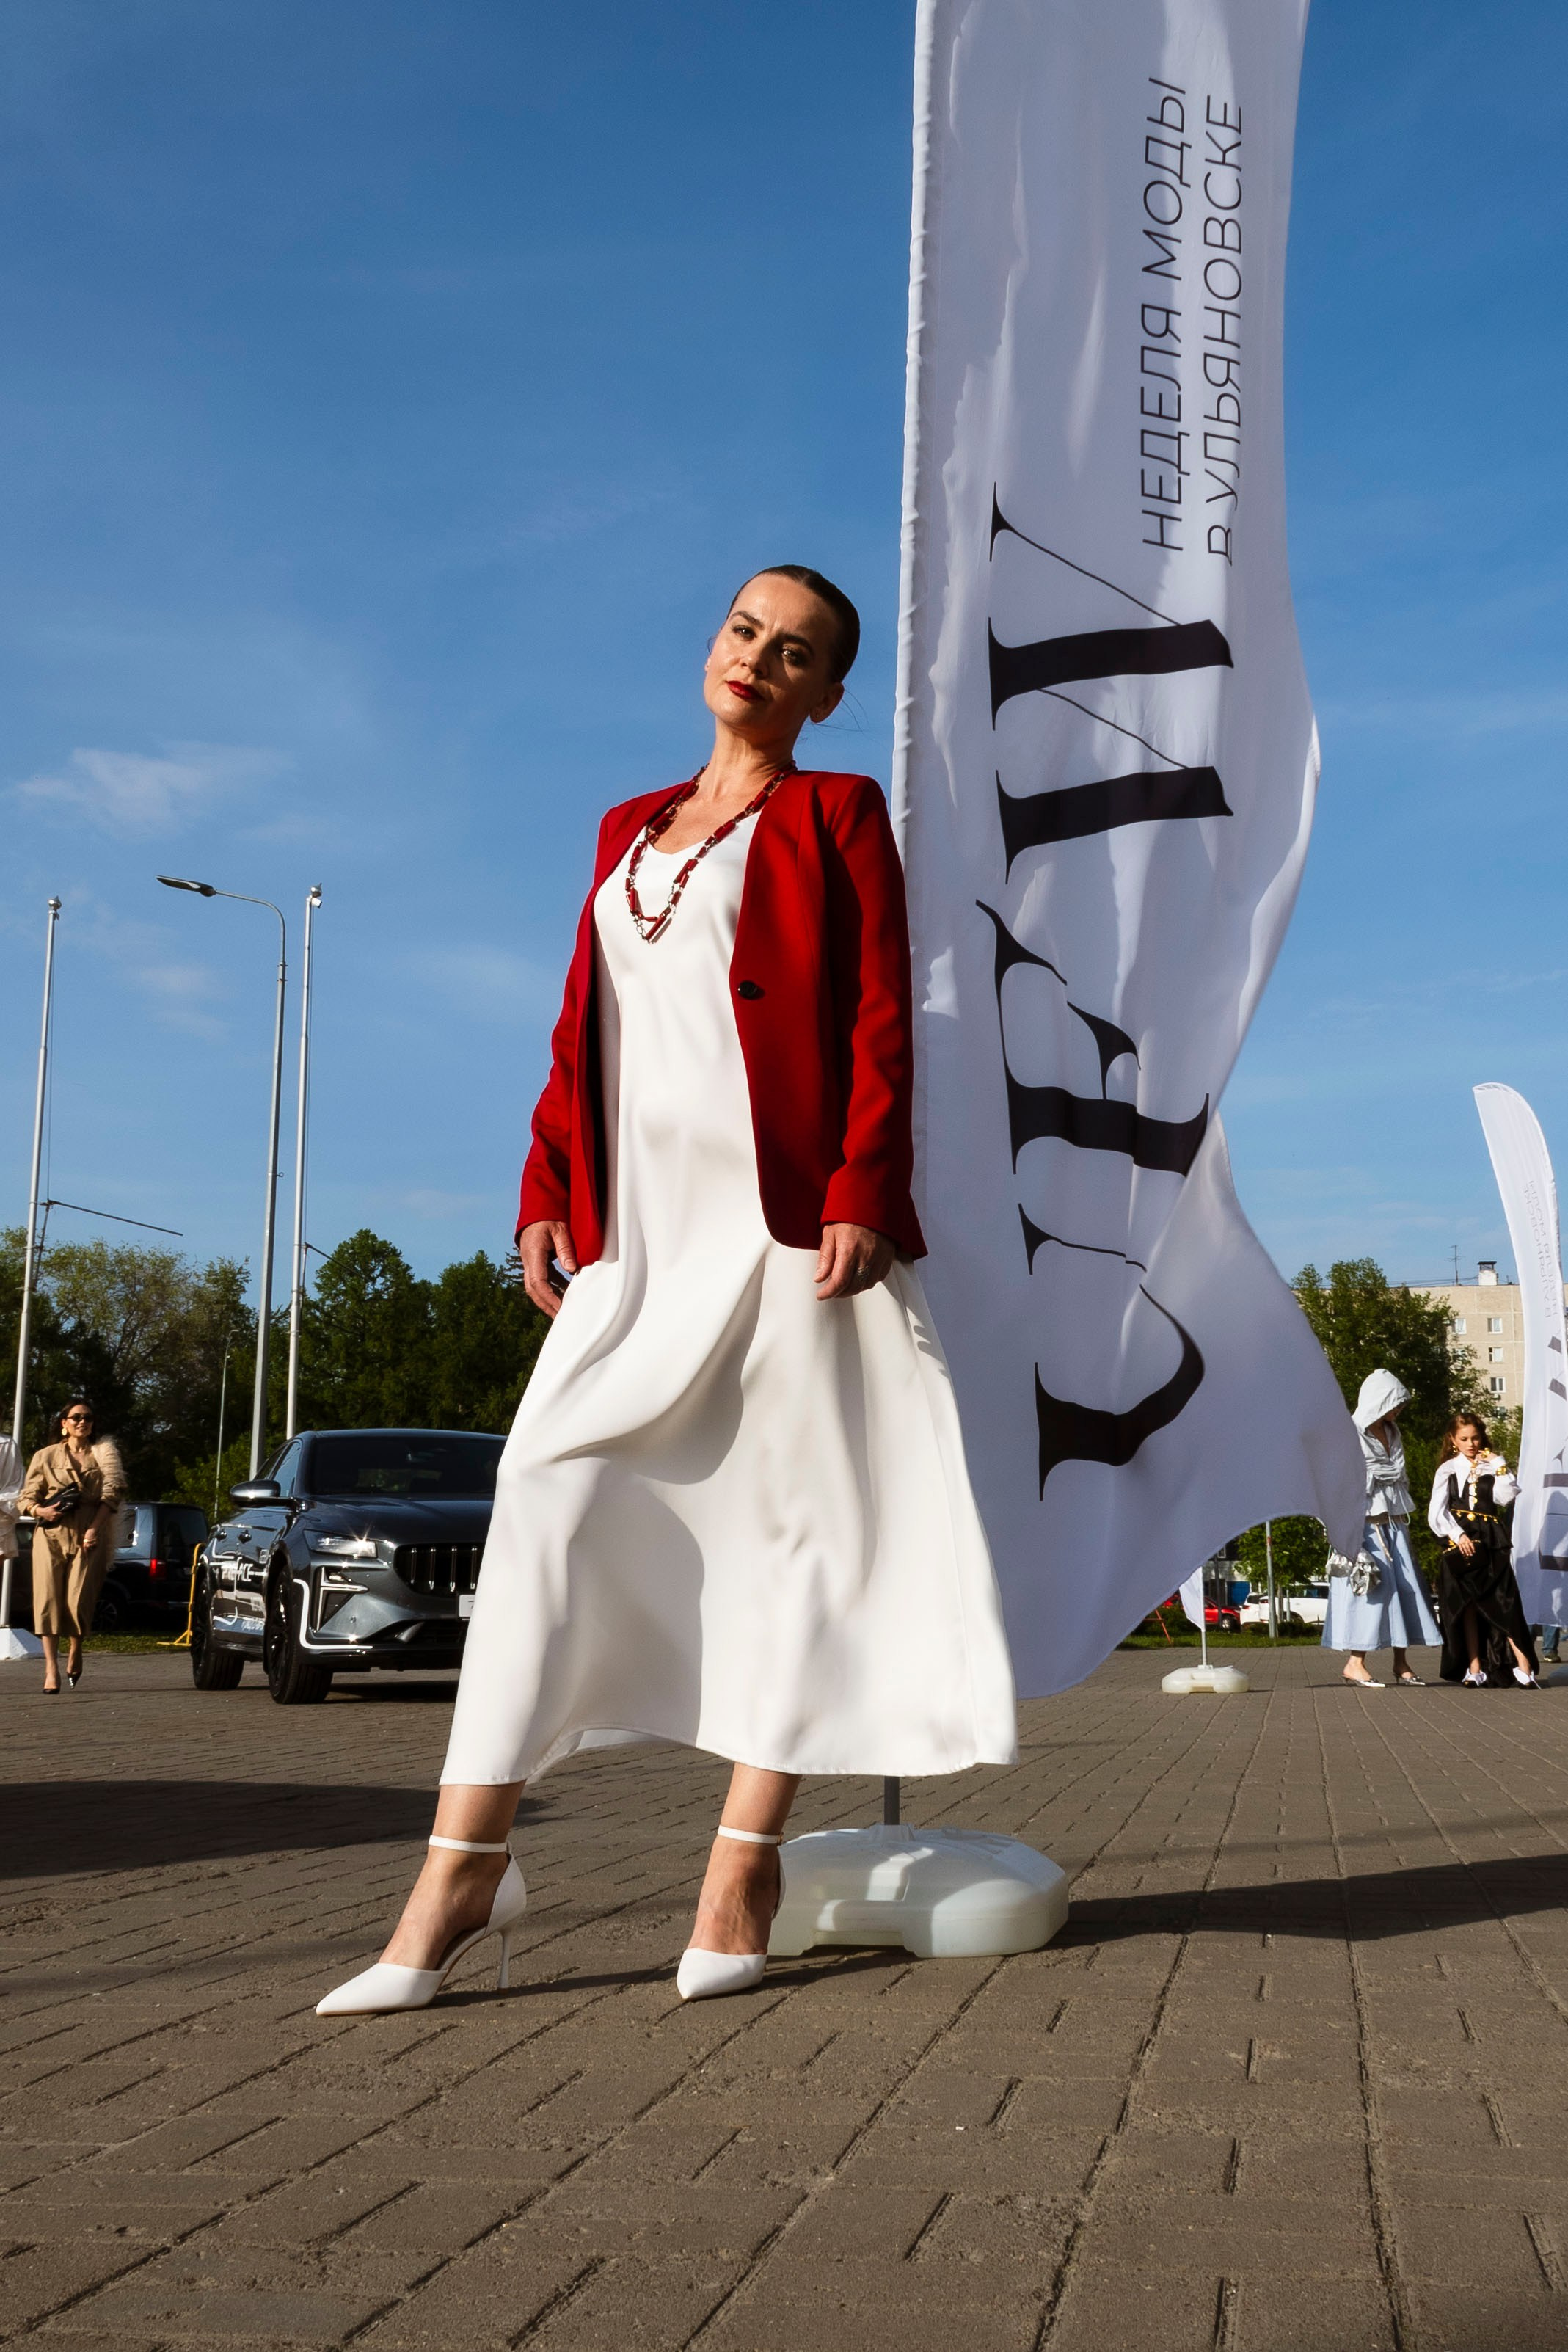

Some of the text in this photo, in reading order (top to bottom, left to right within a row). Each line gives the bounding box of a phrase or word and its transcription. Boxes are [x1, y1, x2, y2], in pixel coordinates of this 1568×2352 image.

[1140, 76, 1192, 551] НЕДЕЛЯ МОДЫ
[1203, 94, 1242, 567] В УЛЬЯНОВСКЕ
